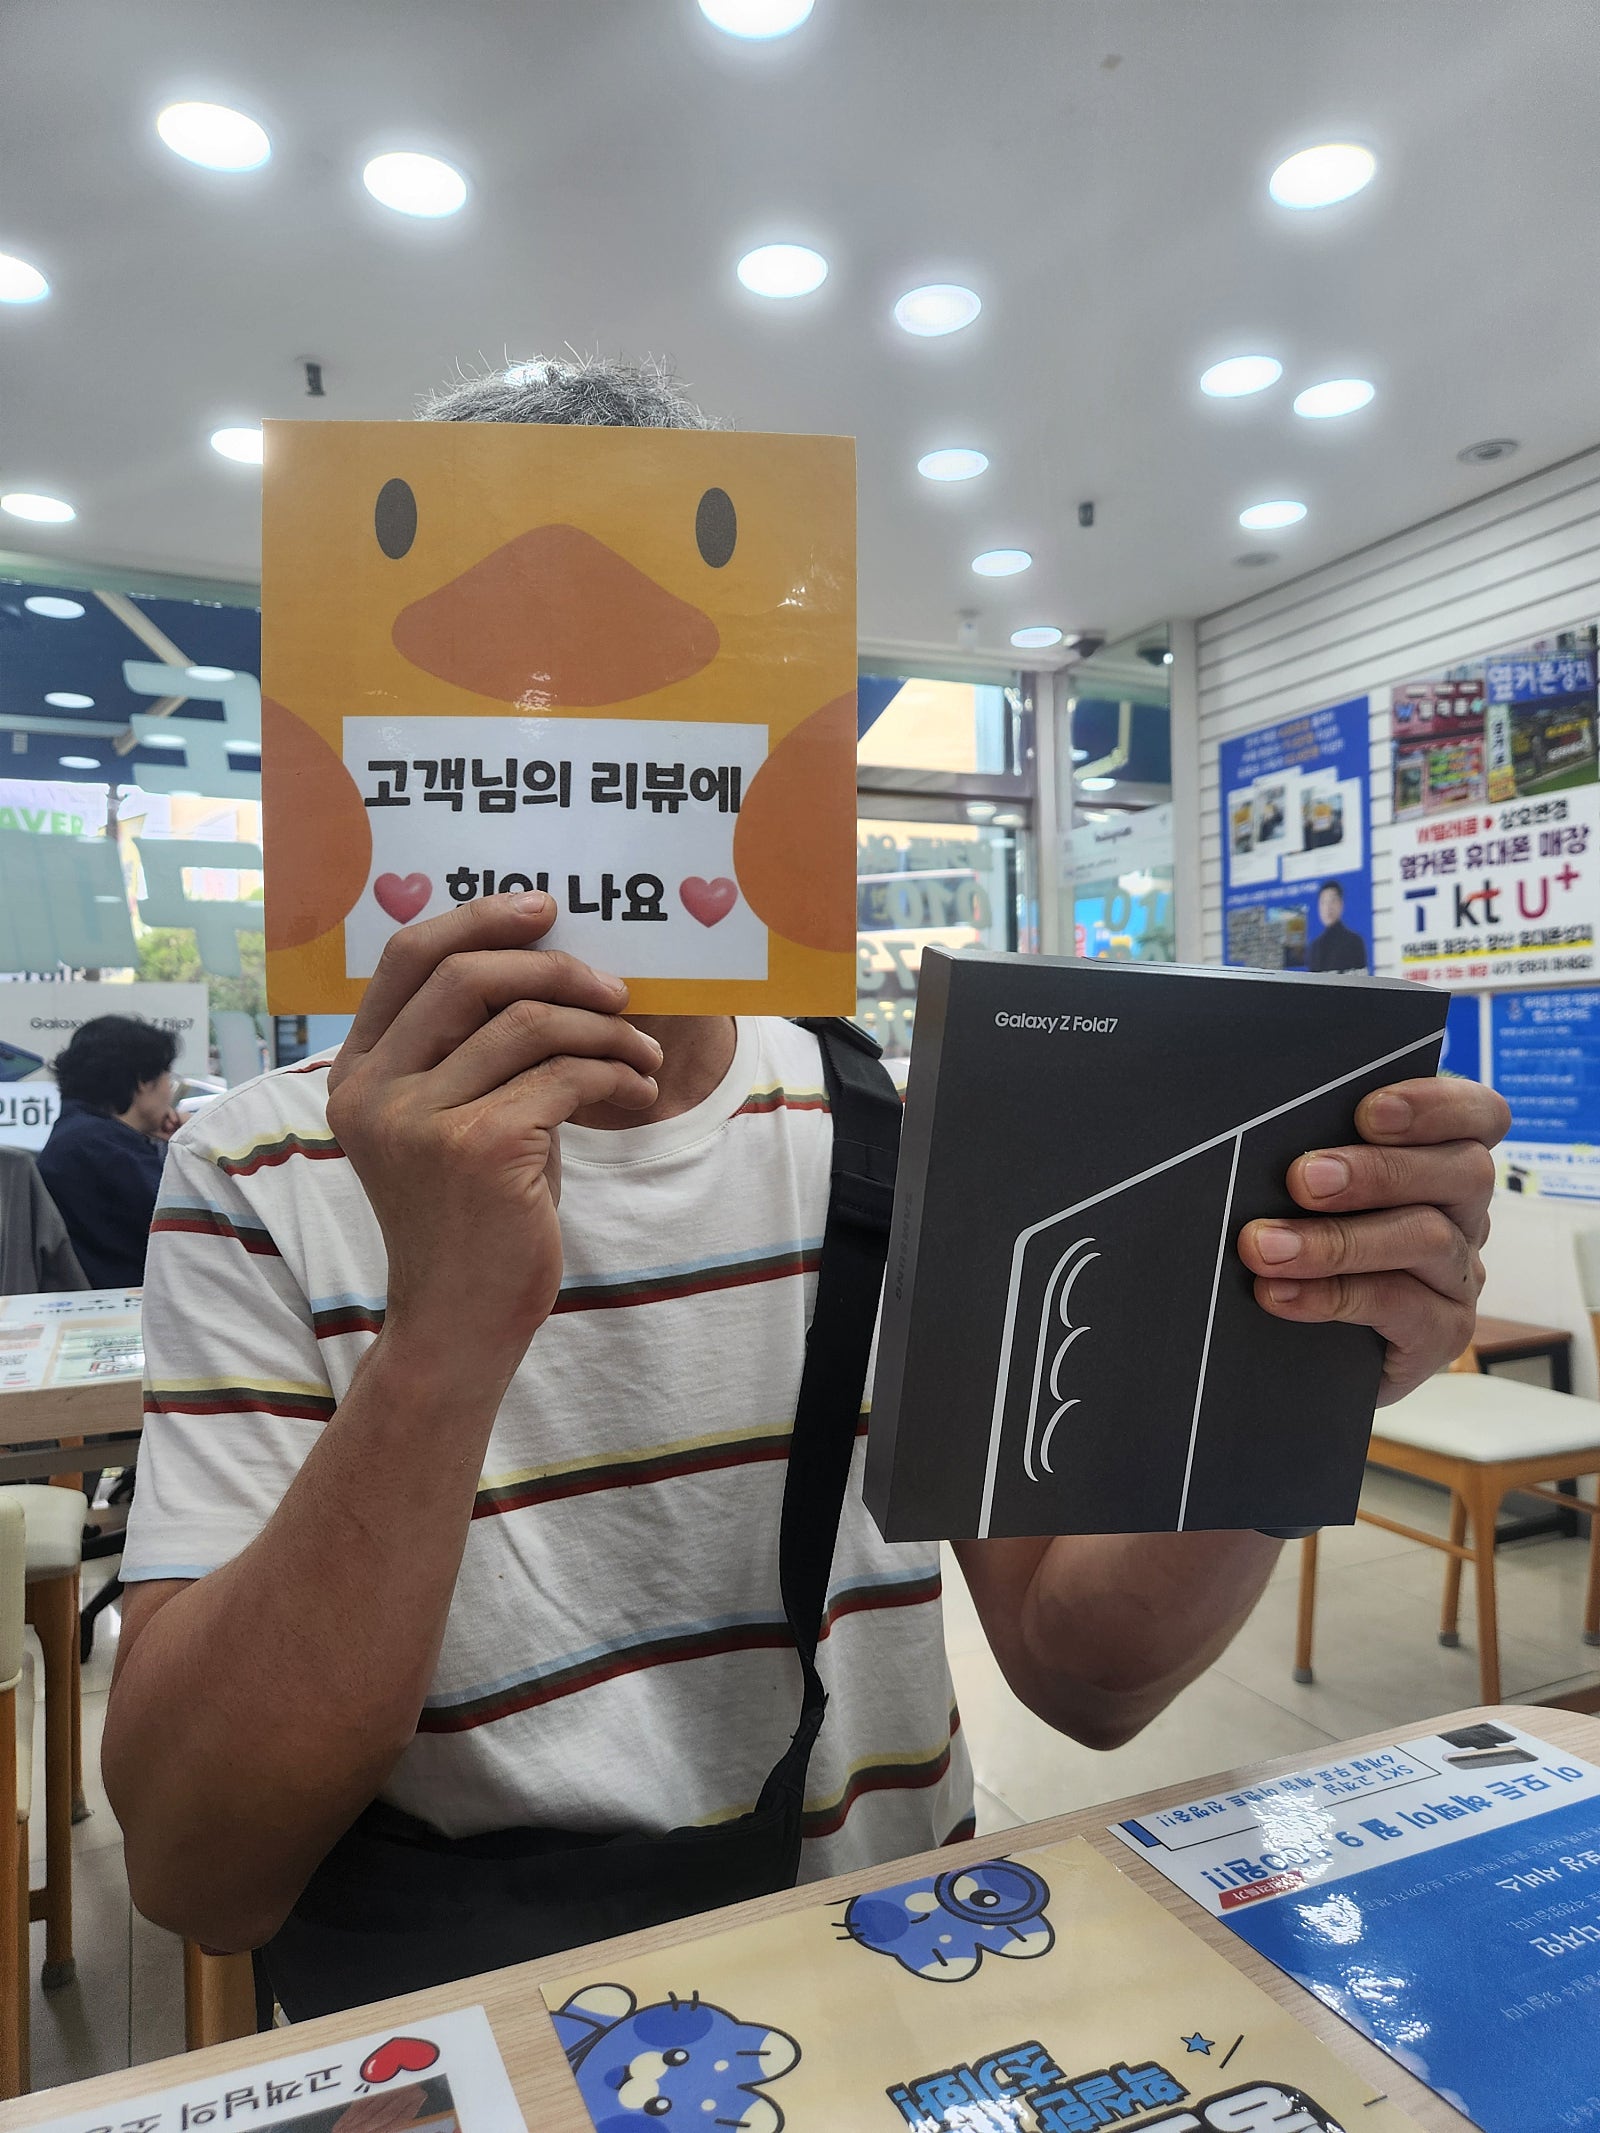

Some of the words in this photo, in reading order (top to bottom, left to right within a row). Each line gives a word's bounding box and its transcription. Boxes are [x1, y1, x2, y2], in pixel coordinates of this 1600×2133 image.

[364, 757, 572, 814] 고객님의
[590, 761, 742, 814] 리뷰에
[1466, 834, 1531, 870] 휴대폰
[1539, 823, 1590, 857] 매장
[567, 872, 669, 922] 나요
[1404, 887, 1438, 933] T
[1455, 879, 1501, 928] kt
[1517, 863, 1580, 919] U+
[994, 1010, 1059, 1034] Galaxy
[1060, 1015, 1071, 1030] Z
[1073, 1016, 1119, 1034] Fold7
[1315, 1766, 1352, 1782] 무료
[1350, 1753, 1394, 1773] 6개월
[1380, 1764, 1414, 1782] SKT
[1542, 1766, 1583, 1782] 이
[1322, 1774, 1375, 1796] 고객님
[1484, 1774, 1551, 1800] 모든
[1156, 1801, 1227, 1827] 진행중!!
[1395, 1795, 1493, 1830] 혜택이
[1358, 1818, 1404, 1841] 월
[1495, 1865, 1563, 1893] 서비스
[1528, 1924, 1600, 1958] 디자인
[182, 2064, 343, 2131] 고객님의
[890, 2043, 1063, 2133] 초기화!
[1031, 2065, 1188, 2133] 확실한
